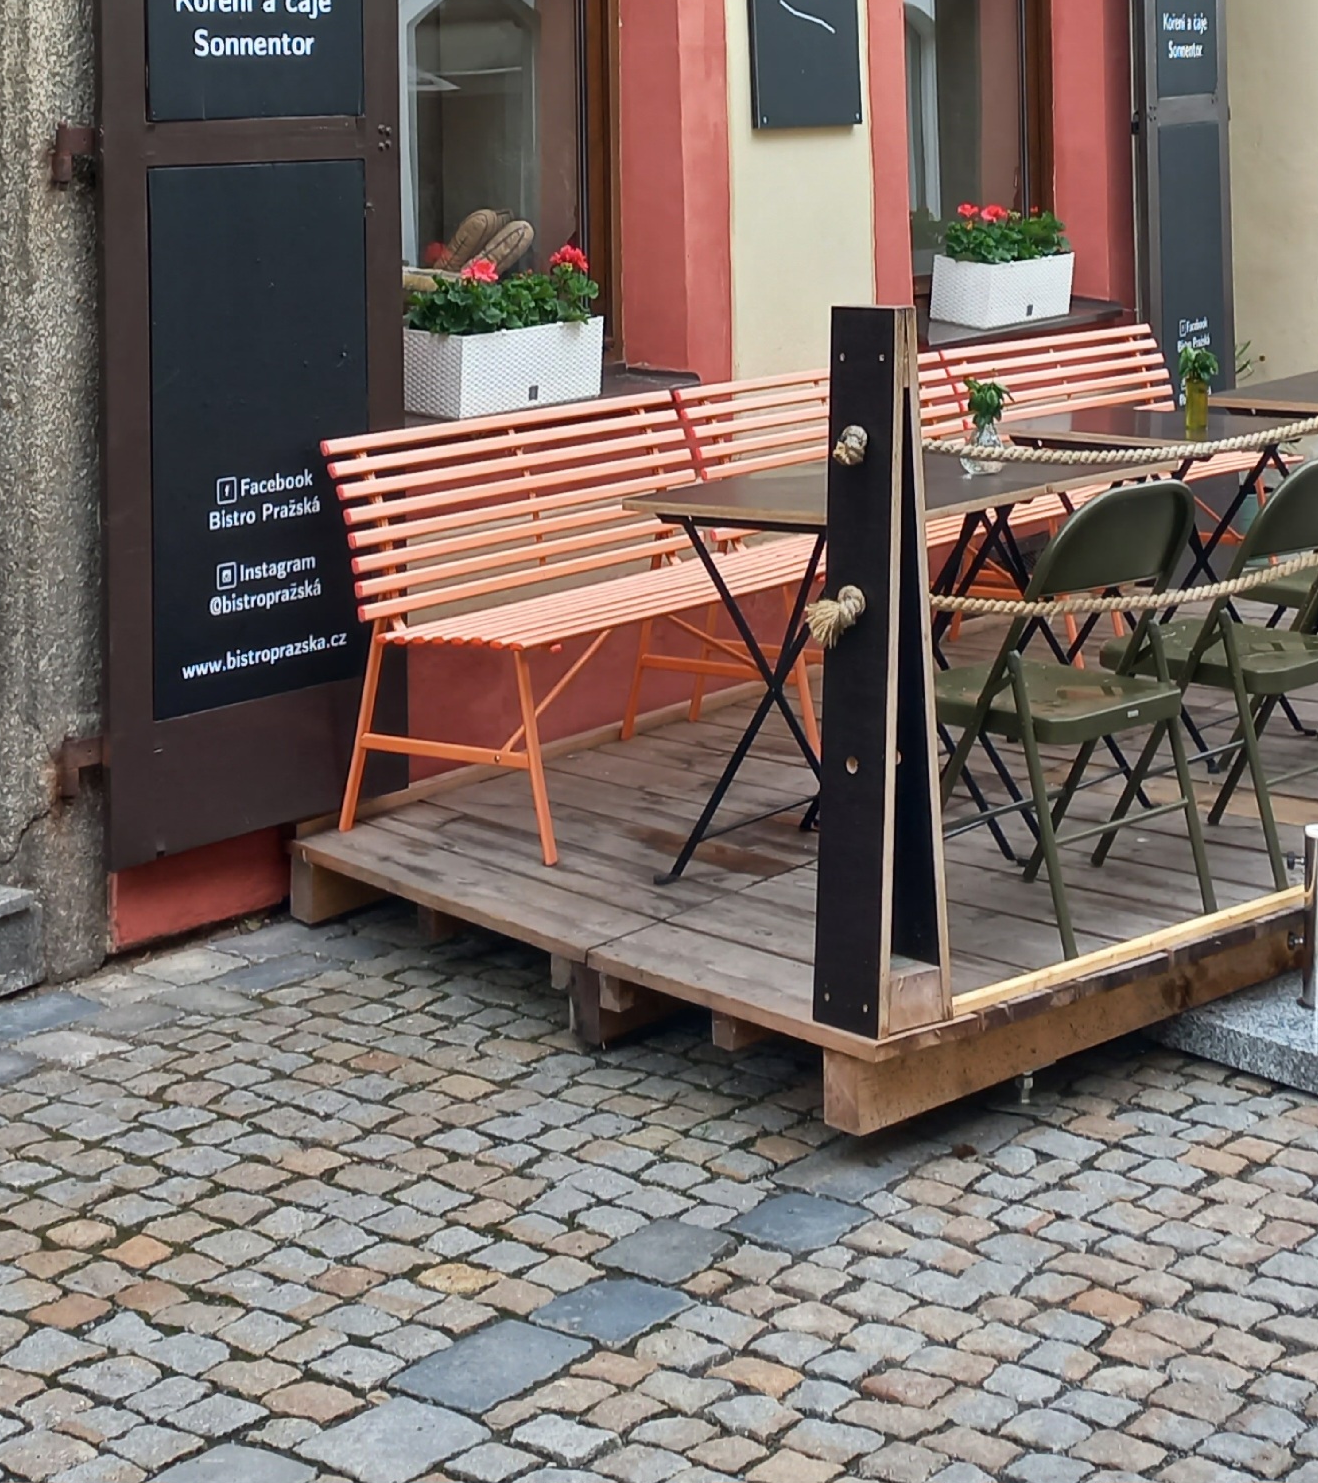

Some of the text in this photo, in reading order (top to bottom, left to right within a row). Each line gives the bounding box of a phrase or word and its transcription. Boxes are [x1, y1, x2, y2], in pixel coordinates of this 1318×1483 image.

[193, 28, 315, 57] Sonnentor
[240, 468, 313, 498] Facebook
[208, 507, 256, 531] Bistro
[239, 555, 316, 582] Instagram
[182, 631, 348, 680] www.bistroprazska.cz
